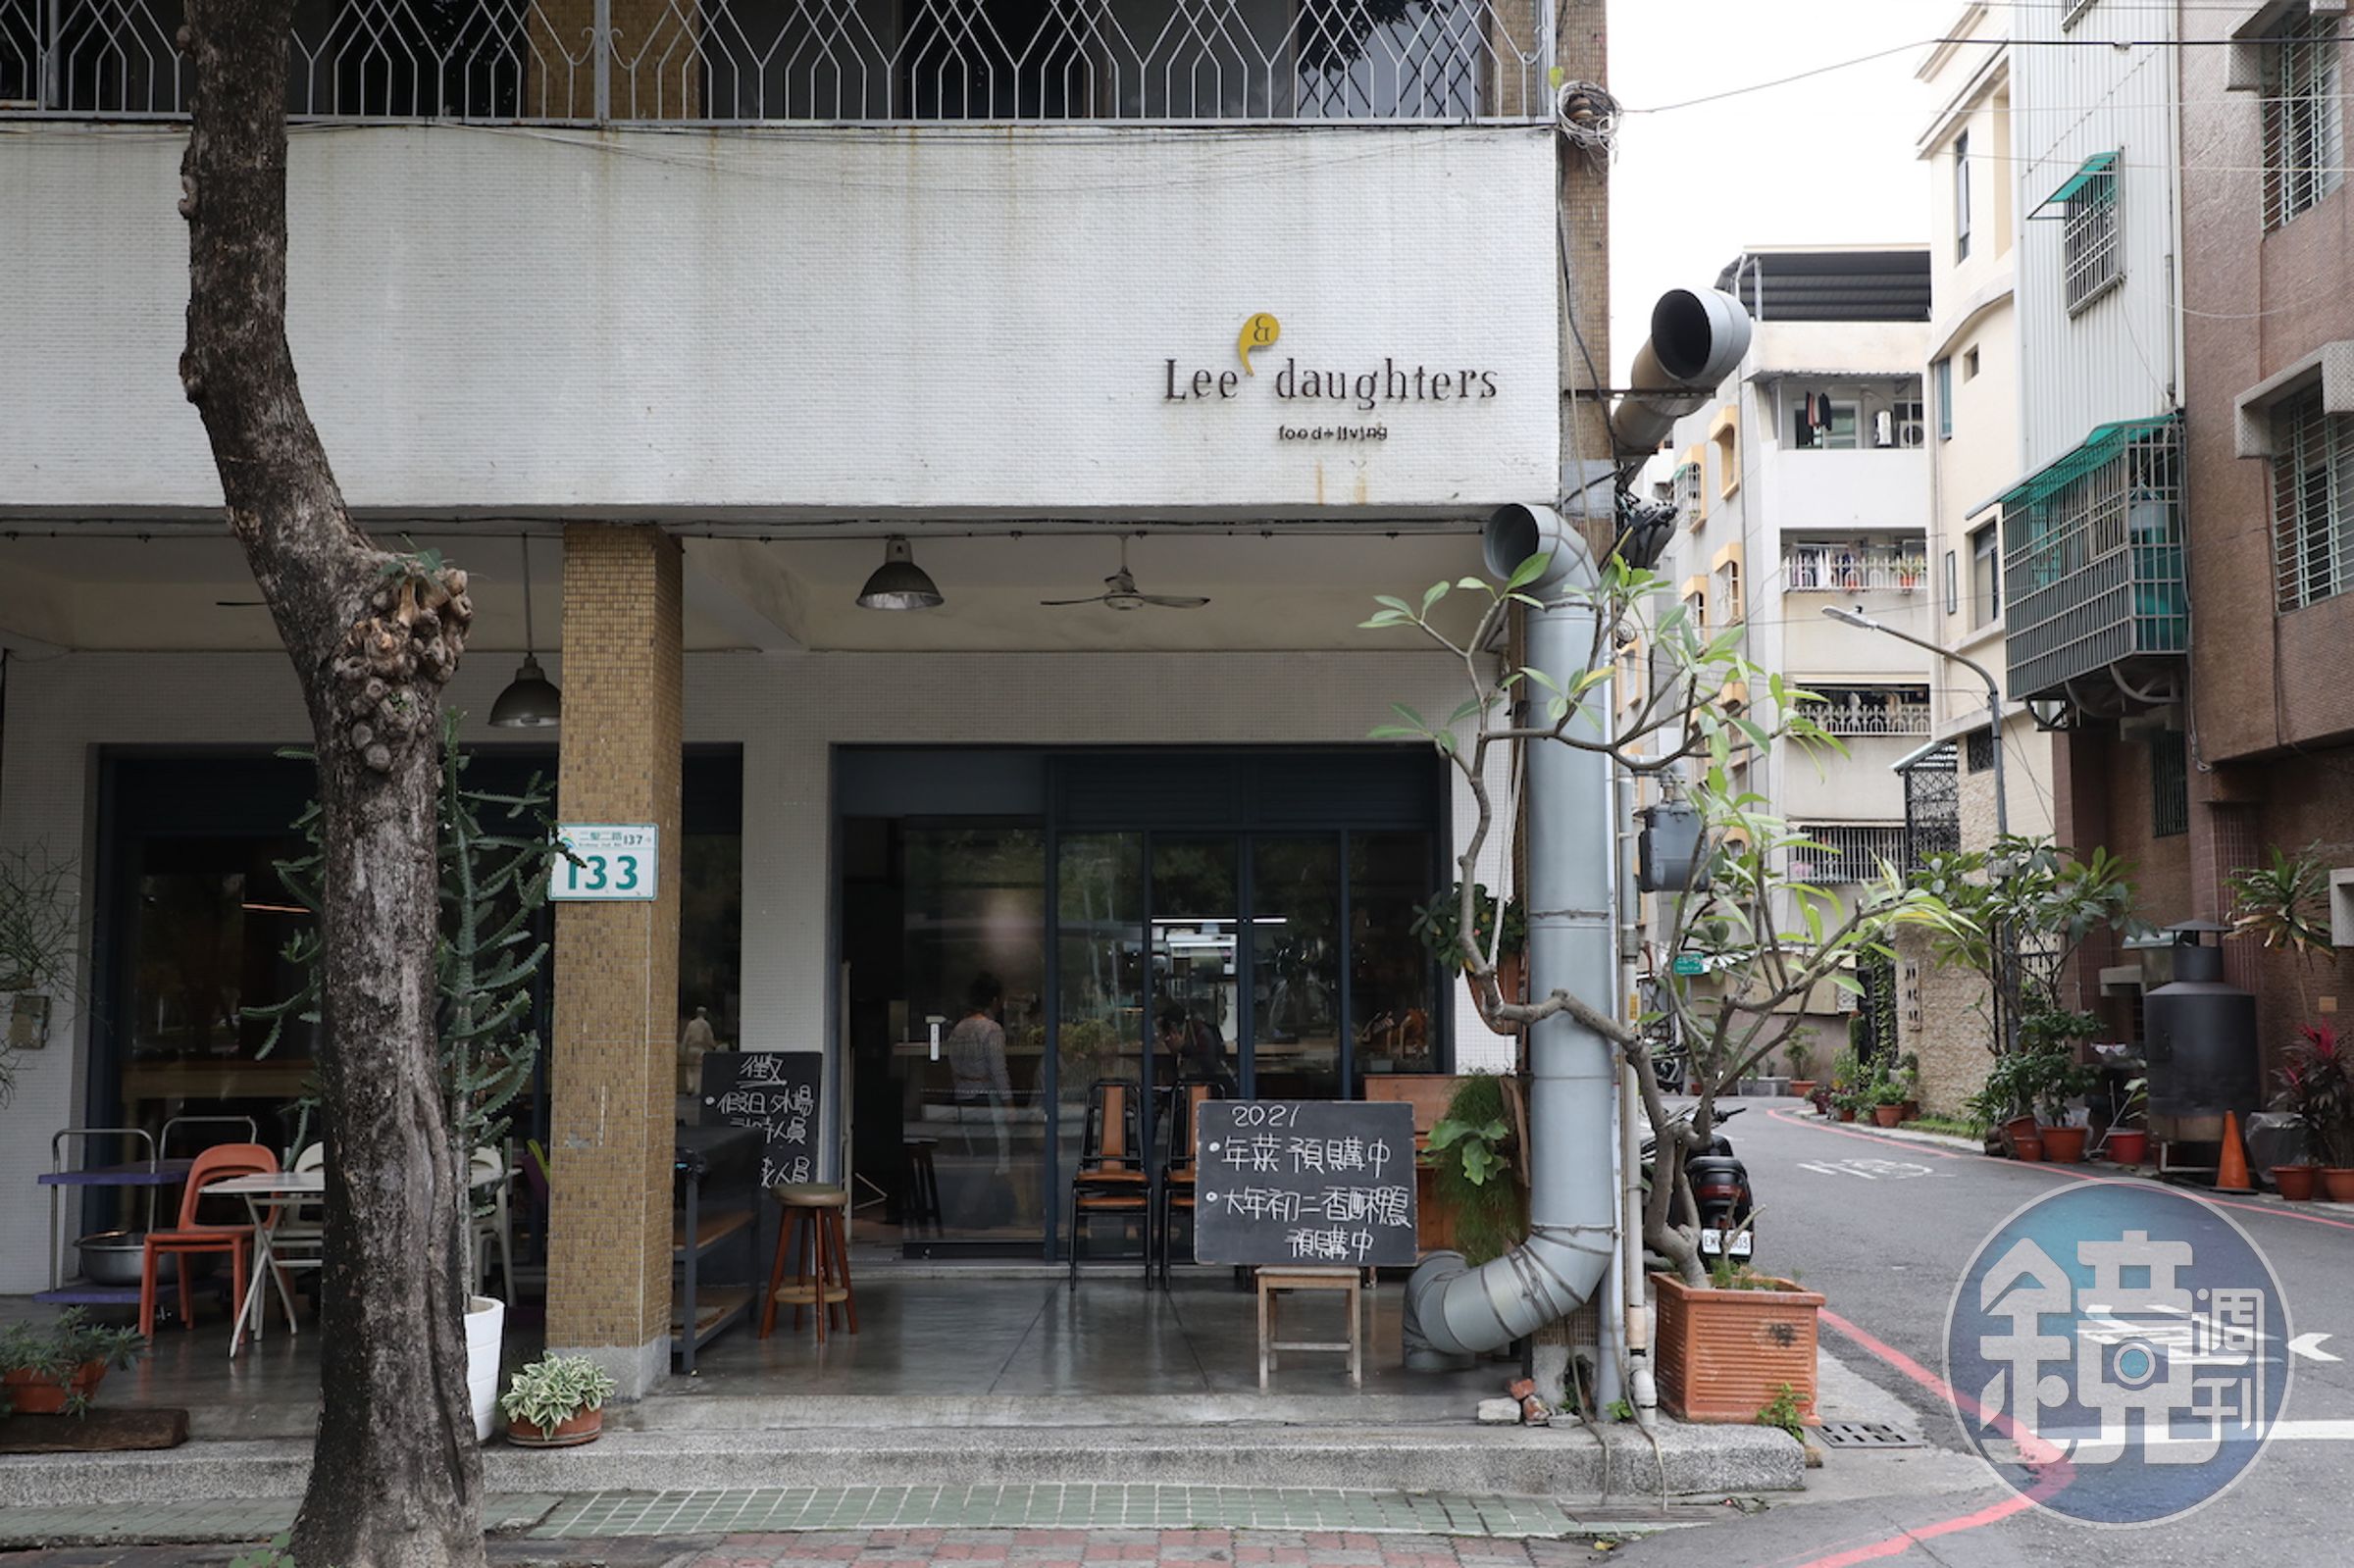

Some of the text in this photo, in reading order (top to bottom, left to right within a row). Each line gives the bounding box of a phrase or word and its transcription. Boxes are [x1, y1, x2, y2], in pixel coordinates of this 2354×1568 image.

[1164, 358, 1238, 400] Lee
[1275, 358, 1498, 410] daughters
[623, 834, 643, 845] 137
[568, 855, 639, 890] 133
[1232, 1104, 1301, 1128] 2021
[1221, 1133, 1391, 1179] 年菜預購中
[1223, 1185, 1413, 1228] 大年初二香酥鴨
[1285, 1224, 1374, 1263] 預購中
